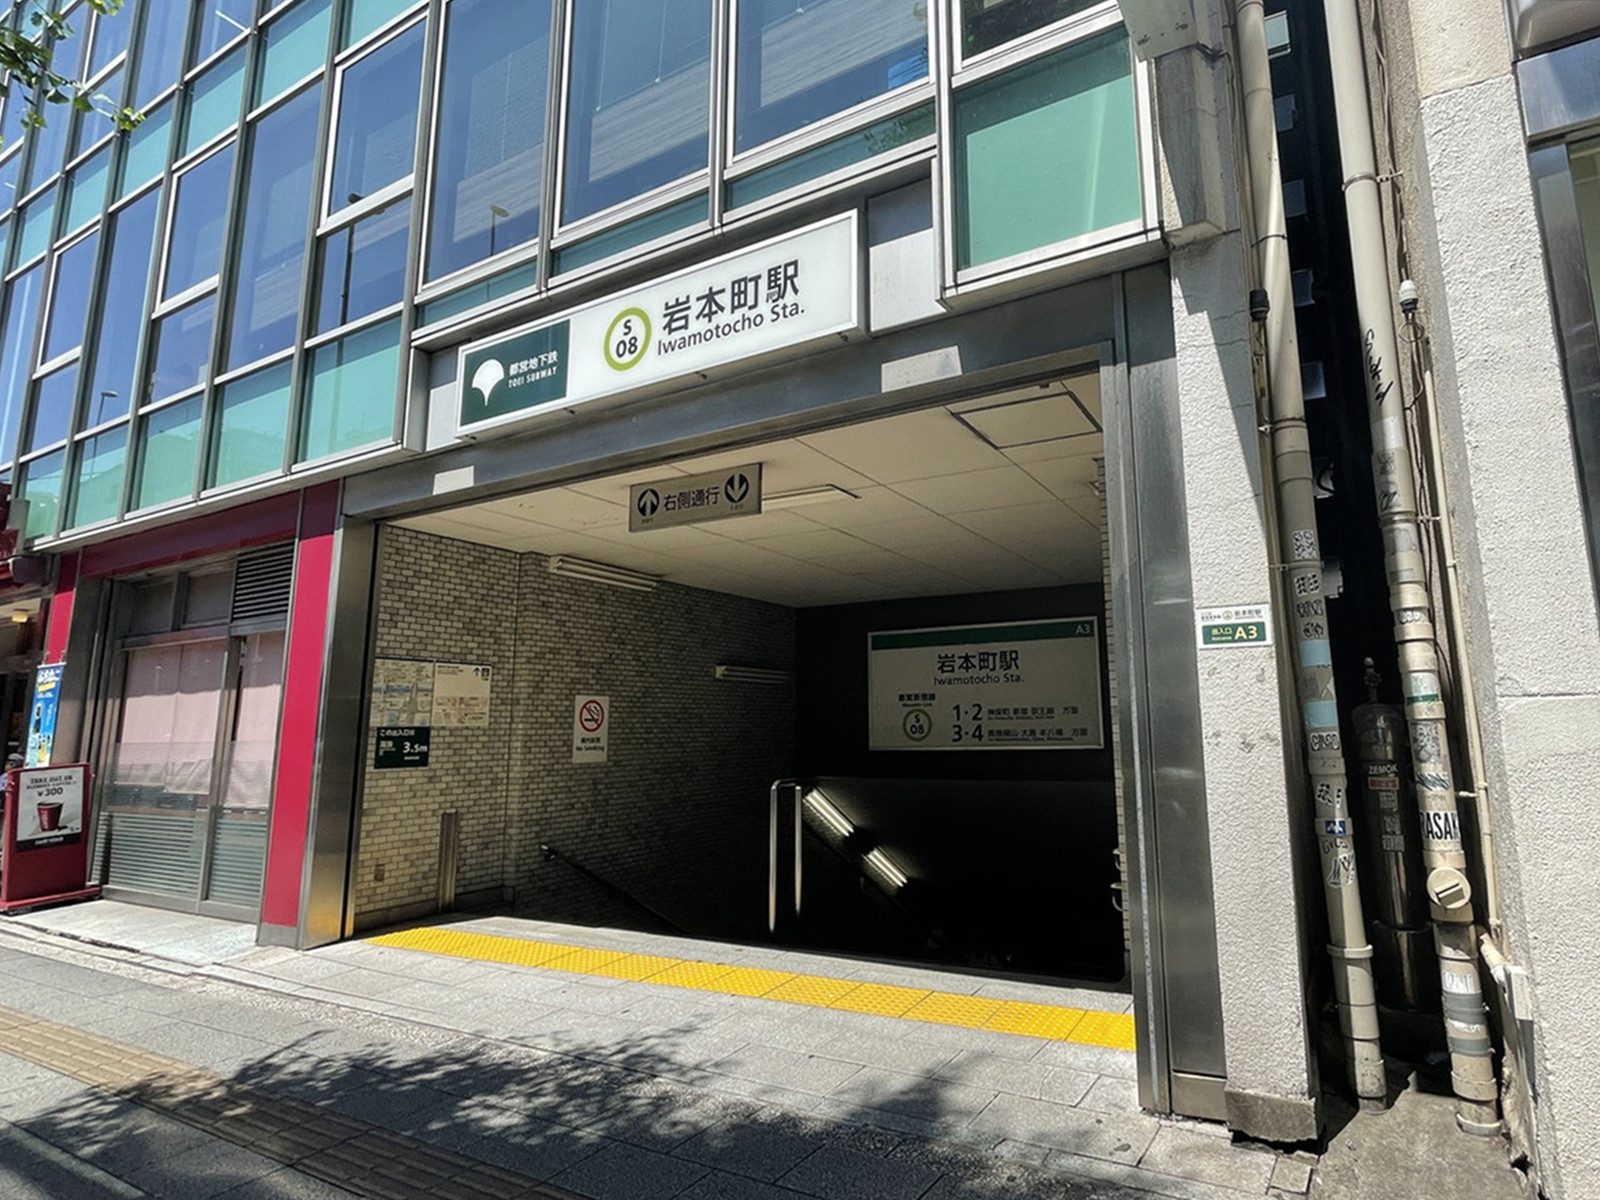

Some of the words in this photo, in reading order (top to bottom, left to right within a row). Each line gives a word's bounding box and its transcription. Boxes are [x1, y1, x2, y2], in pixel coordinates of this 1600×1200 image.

[662, 259, 800, 336] 岩本町駅
[622, 319, 633, 337] S
[657, 312, 764, 356] Iwamotocho
[770, 301, 806, 320] Sta.
[615, 336, 639, 358] 08
[509, 350, 558, 376] 都営地下鉄
[508, 375, 525, 388] TOEI
[526, 366, 558, 383] SUBWAY
[664, 486, 720, 511] 右側通行
[1075, 624, 1091, 635] A3
[1234, 625, 1258, 640] A3
[937, 650, 1020, 674] 岩本町駅
[933, 674, 1000, 686] Iwamotocho
[1003, 673, 1025, 683] Sta.
[909, 723, 925, 735] 08
[914, 713, 921, 724] S
